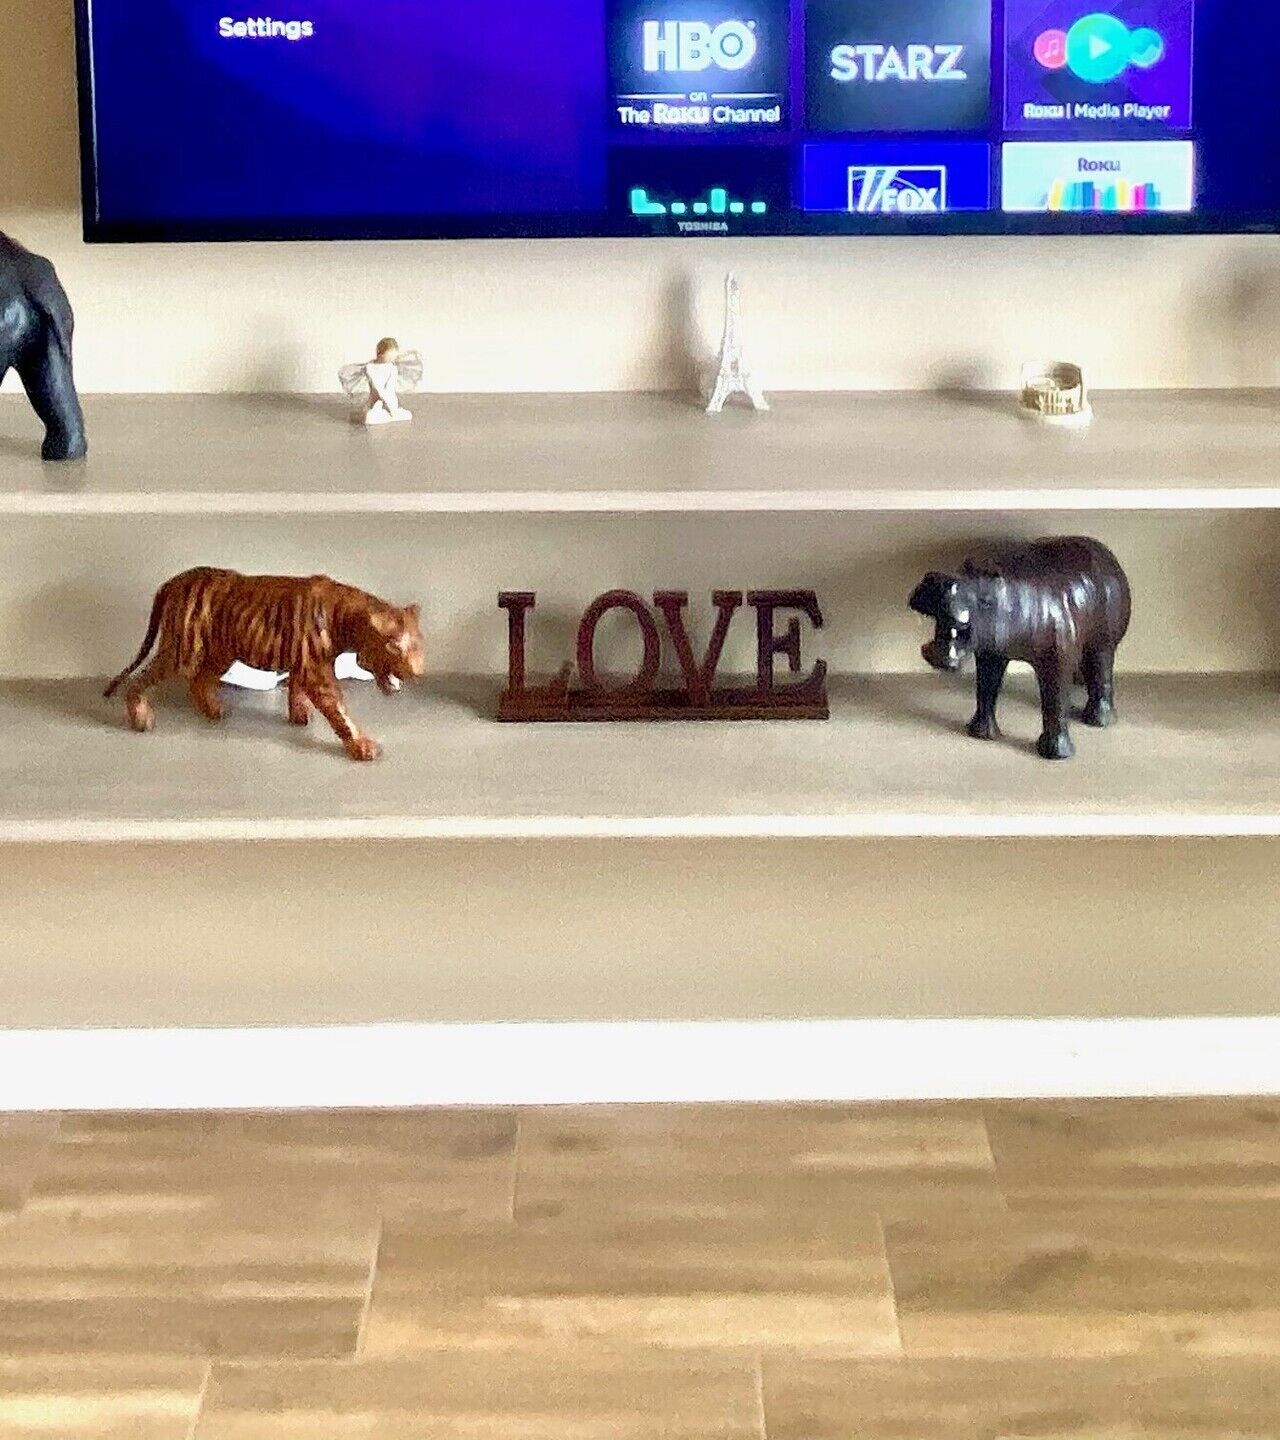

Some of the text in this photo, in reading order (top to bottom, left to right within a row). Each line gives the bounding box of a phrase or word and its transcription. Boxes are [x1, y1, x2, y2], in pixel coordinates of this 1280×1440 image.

[218, 16, 313, 40] Settings
[642, 19, 756, 72] HBO
[830, 43, 968, 82] STARZ
[688, 91, 708, 103] on
[617, 106, 650, 125] The
[712, 105, 780, 125] Channel
[1074, 103, 1120, 120] Media
[1124, 103, 1171, 121] Player
[1078, 157, 1121, 172] Roku
[881, 186, 939, 213] FOX
[497, 588, 827, 712] LOVE
